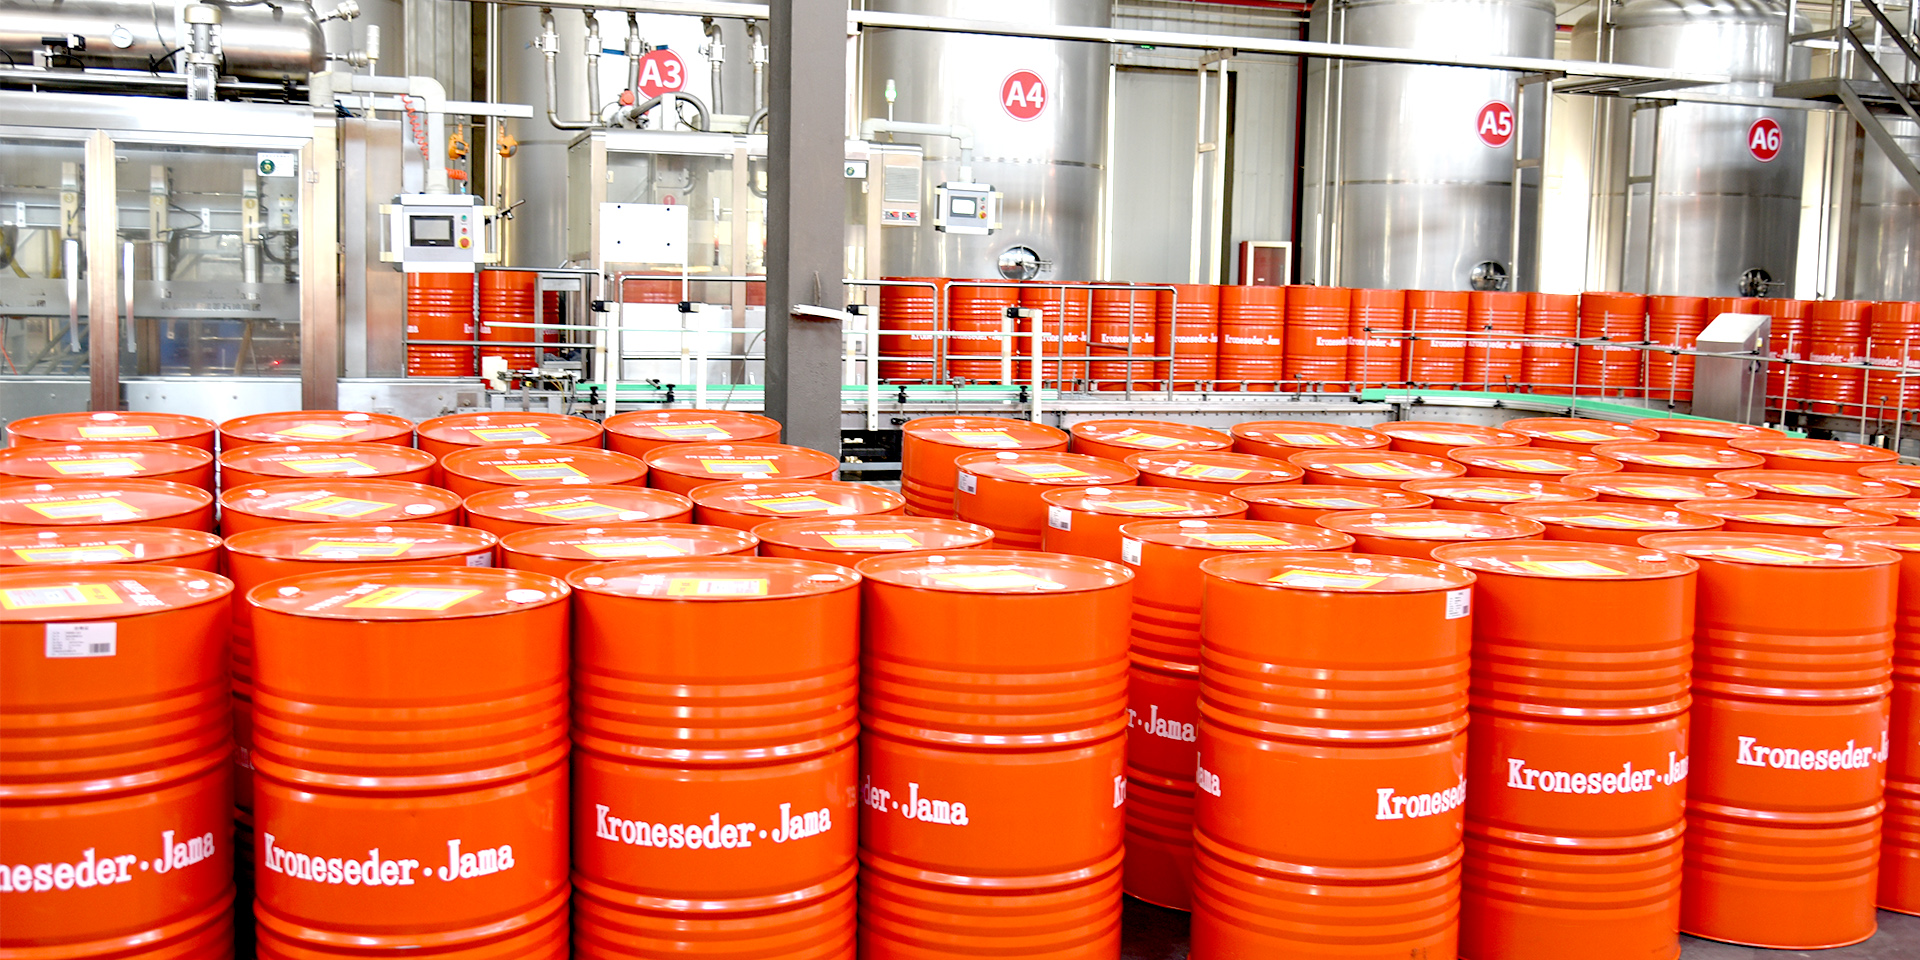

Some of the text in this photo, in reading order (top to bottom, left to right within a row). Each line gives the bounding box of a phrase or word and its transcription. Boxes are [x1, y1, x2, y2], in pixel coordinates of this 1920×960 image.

[640, 59, 682, 88] A3
[1006, 80, 1044, 109] A4
[1480, 111, 1511, 136] A5
[1751, 127, 1779, 151] A6
